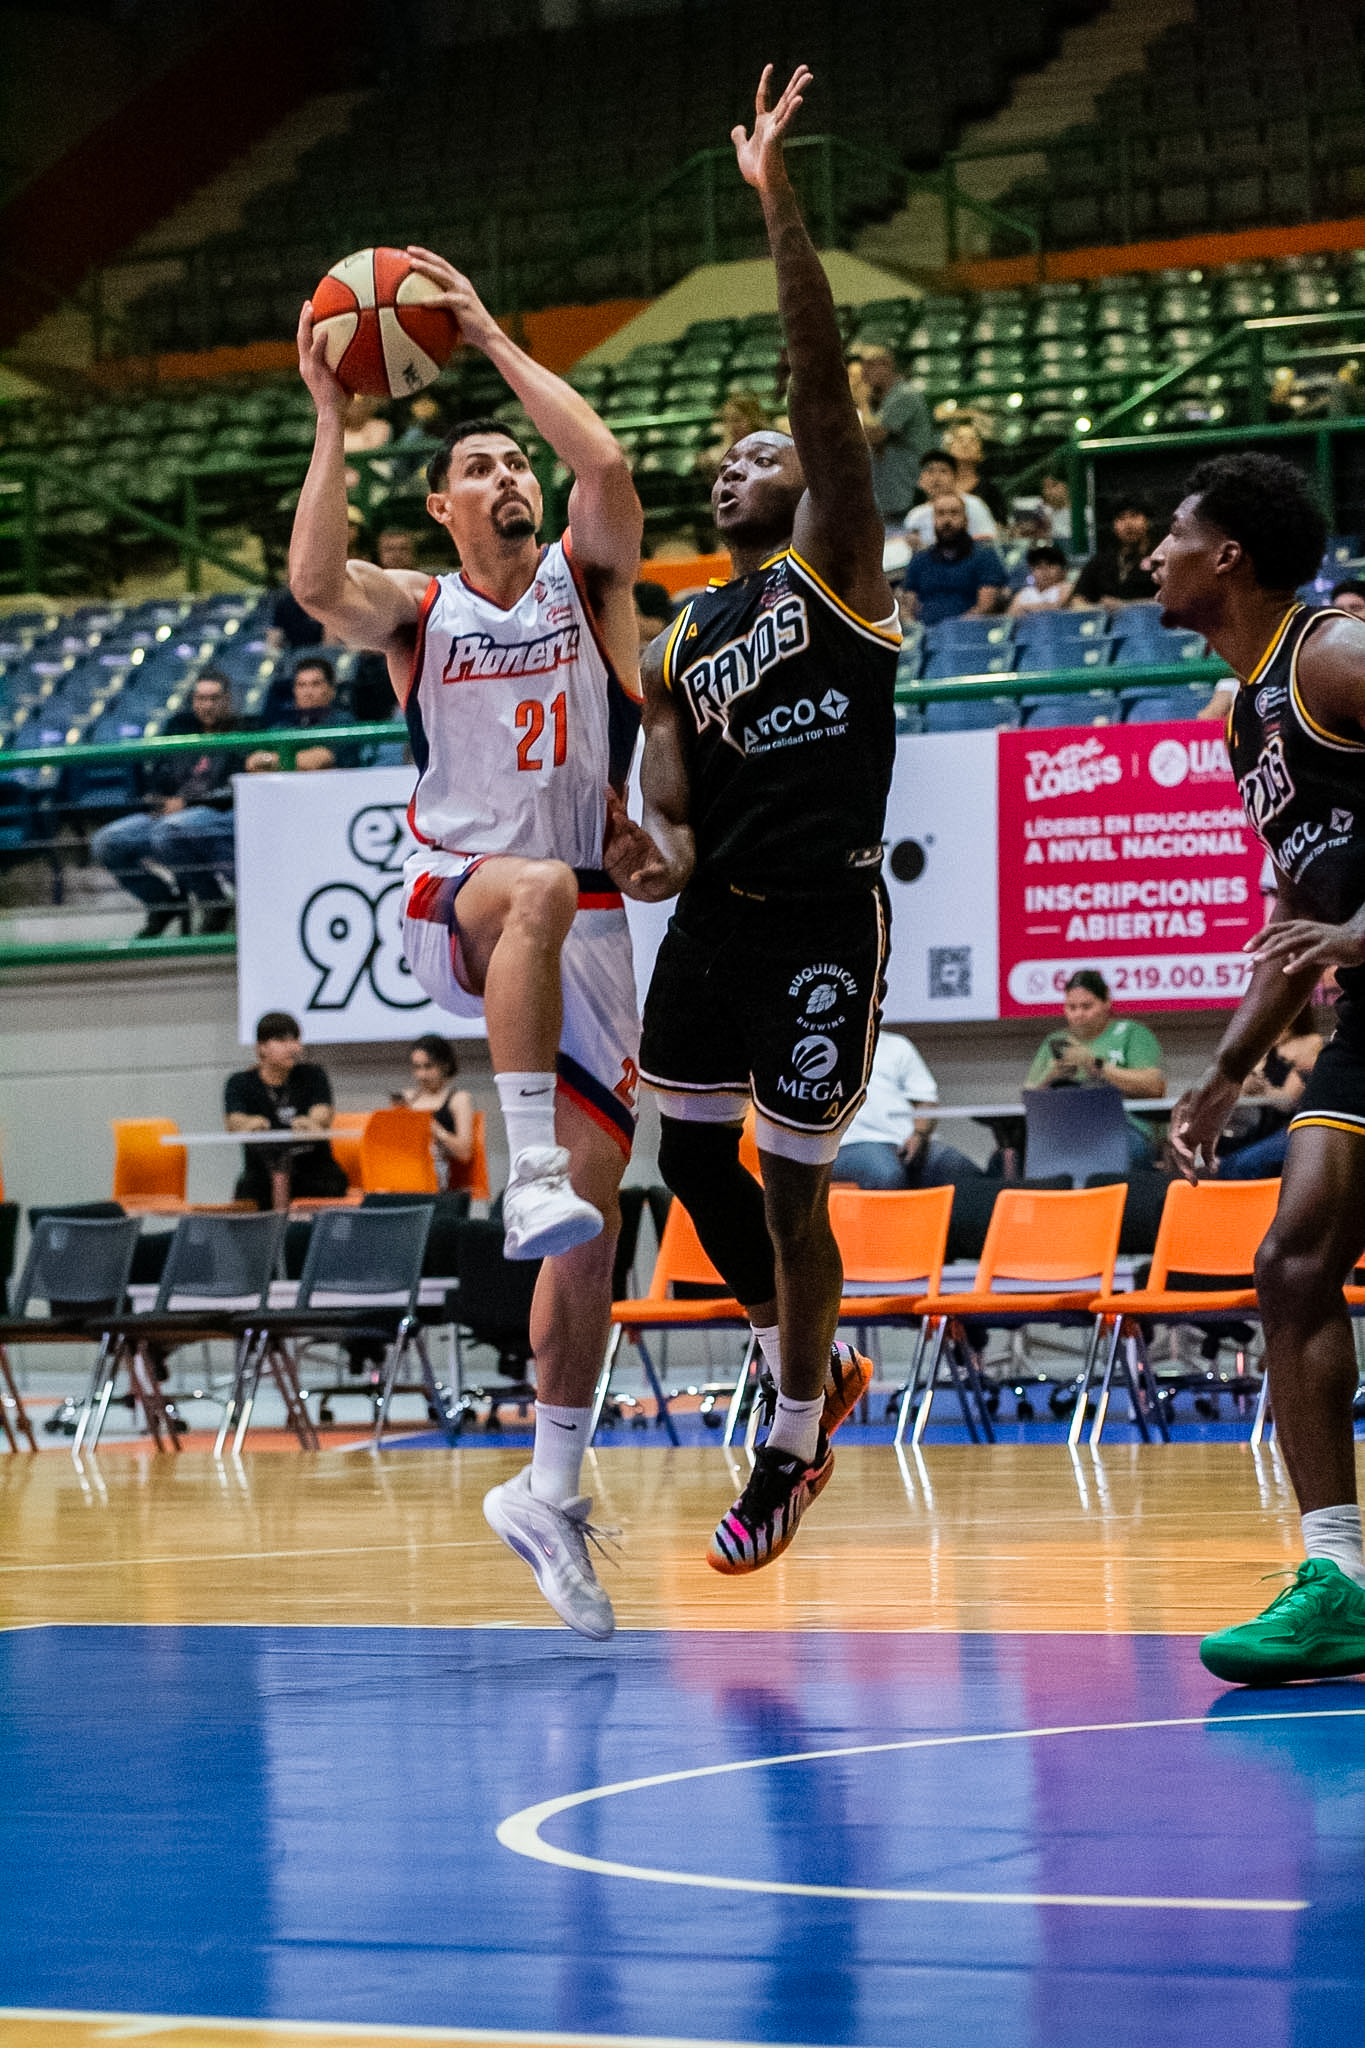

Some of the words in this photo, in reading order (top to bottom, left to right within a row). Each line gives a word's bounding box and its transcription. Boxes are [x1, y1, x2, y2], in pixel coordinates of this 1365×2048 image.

[681, 595, 810, 735] RAYOS
[515, 691, 567, 771] 21
[805, 729, 824, 742] TOP
[825, 724, 847, 737] TIER
[1188, 739, 1233, 772] UA
[1024, 755, 1122, 802] LOBOS
[1239, 736, 1296, 834] AYOS
[1025, 815, 1101, 839] LÍDERES
[1104, 814, 1131, 834] EN
[1133, 807, 1248, 832] EDUCACIÓN
[1024, 841, 1044, 864] A
[1048, 837, 1118, 863] NIVEL
[1122, 831, 1248, 859] NACIONAL
[1025, 876, 1248, 913] INSCRIPCIONES
[1065, 910, 1206, 942] ABIERTAS
[788, 963, 857, 997] BUQUIBICHI
[796, 1015, 846, 1031] BREWING
[777, 1075, 844, 1101] MEGA
